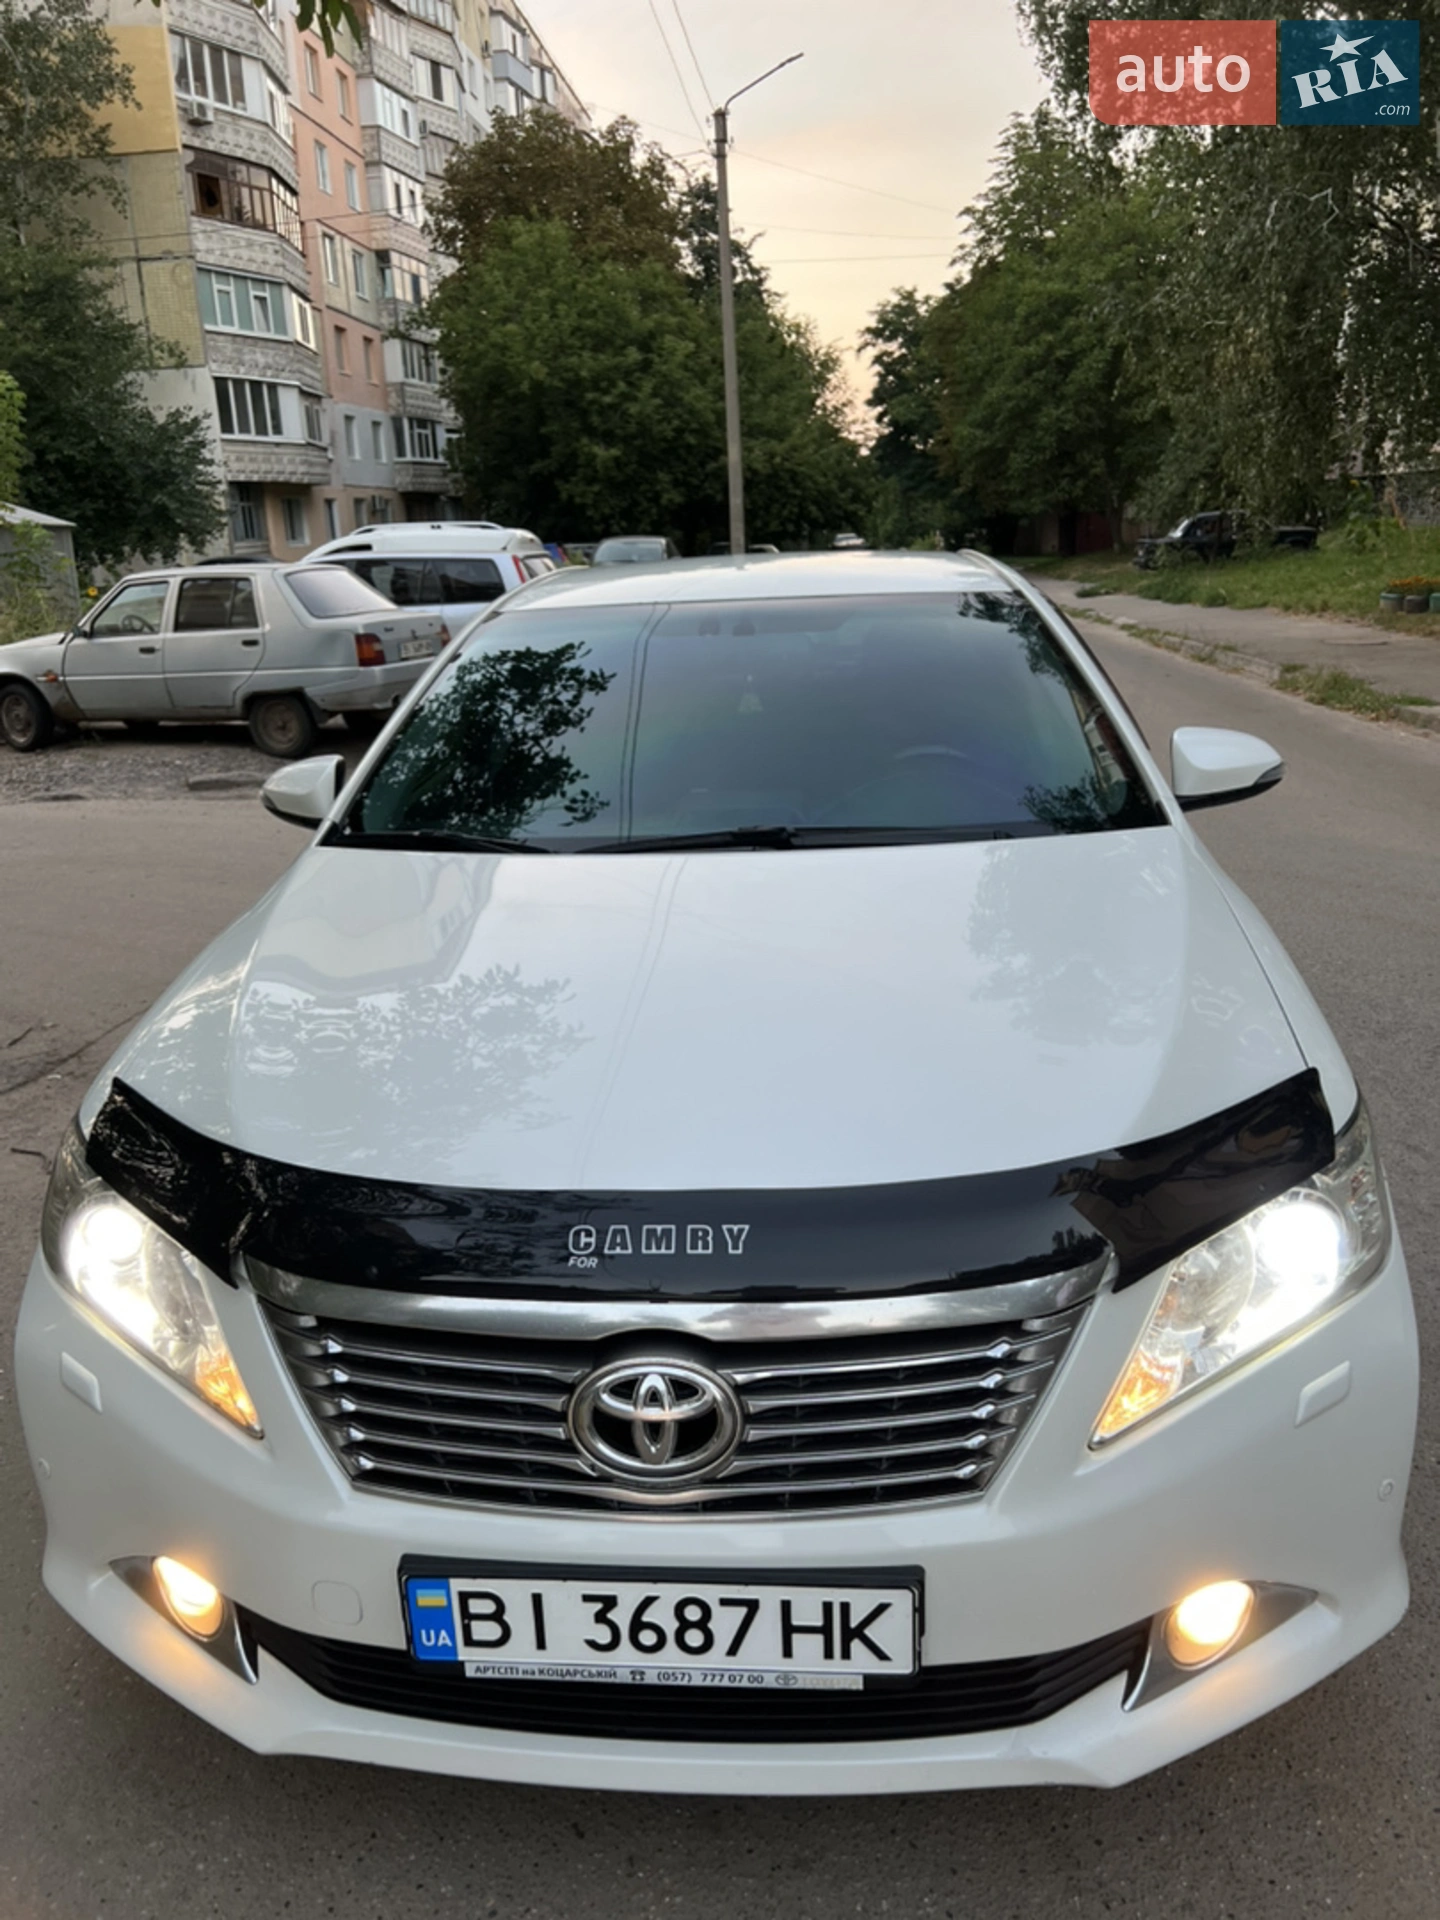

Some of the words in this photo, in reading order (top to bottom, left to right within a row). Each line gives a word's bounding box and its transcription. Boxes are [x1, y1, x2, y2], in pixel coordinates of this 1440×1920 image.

[568, 1224, 750, 1255] CAMRY
[567, 1256, 598, 1268] FOR
[458, 1590, 547, 1651] BI
[581, 1594, 760, 1657] 3687
[780, 1599, 893, 1662] HK
[420, 1629, 453, 1647] UA
[522, 1668, 536, 1676] на
[657, 1671, 693, 1683] (057)
[701, 1672, 724, 1684] 777
[728, 1674, 744, 1684] 07
[747, 1675, 764, 1685] 00
